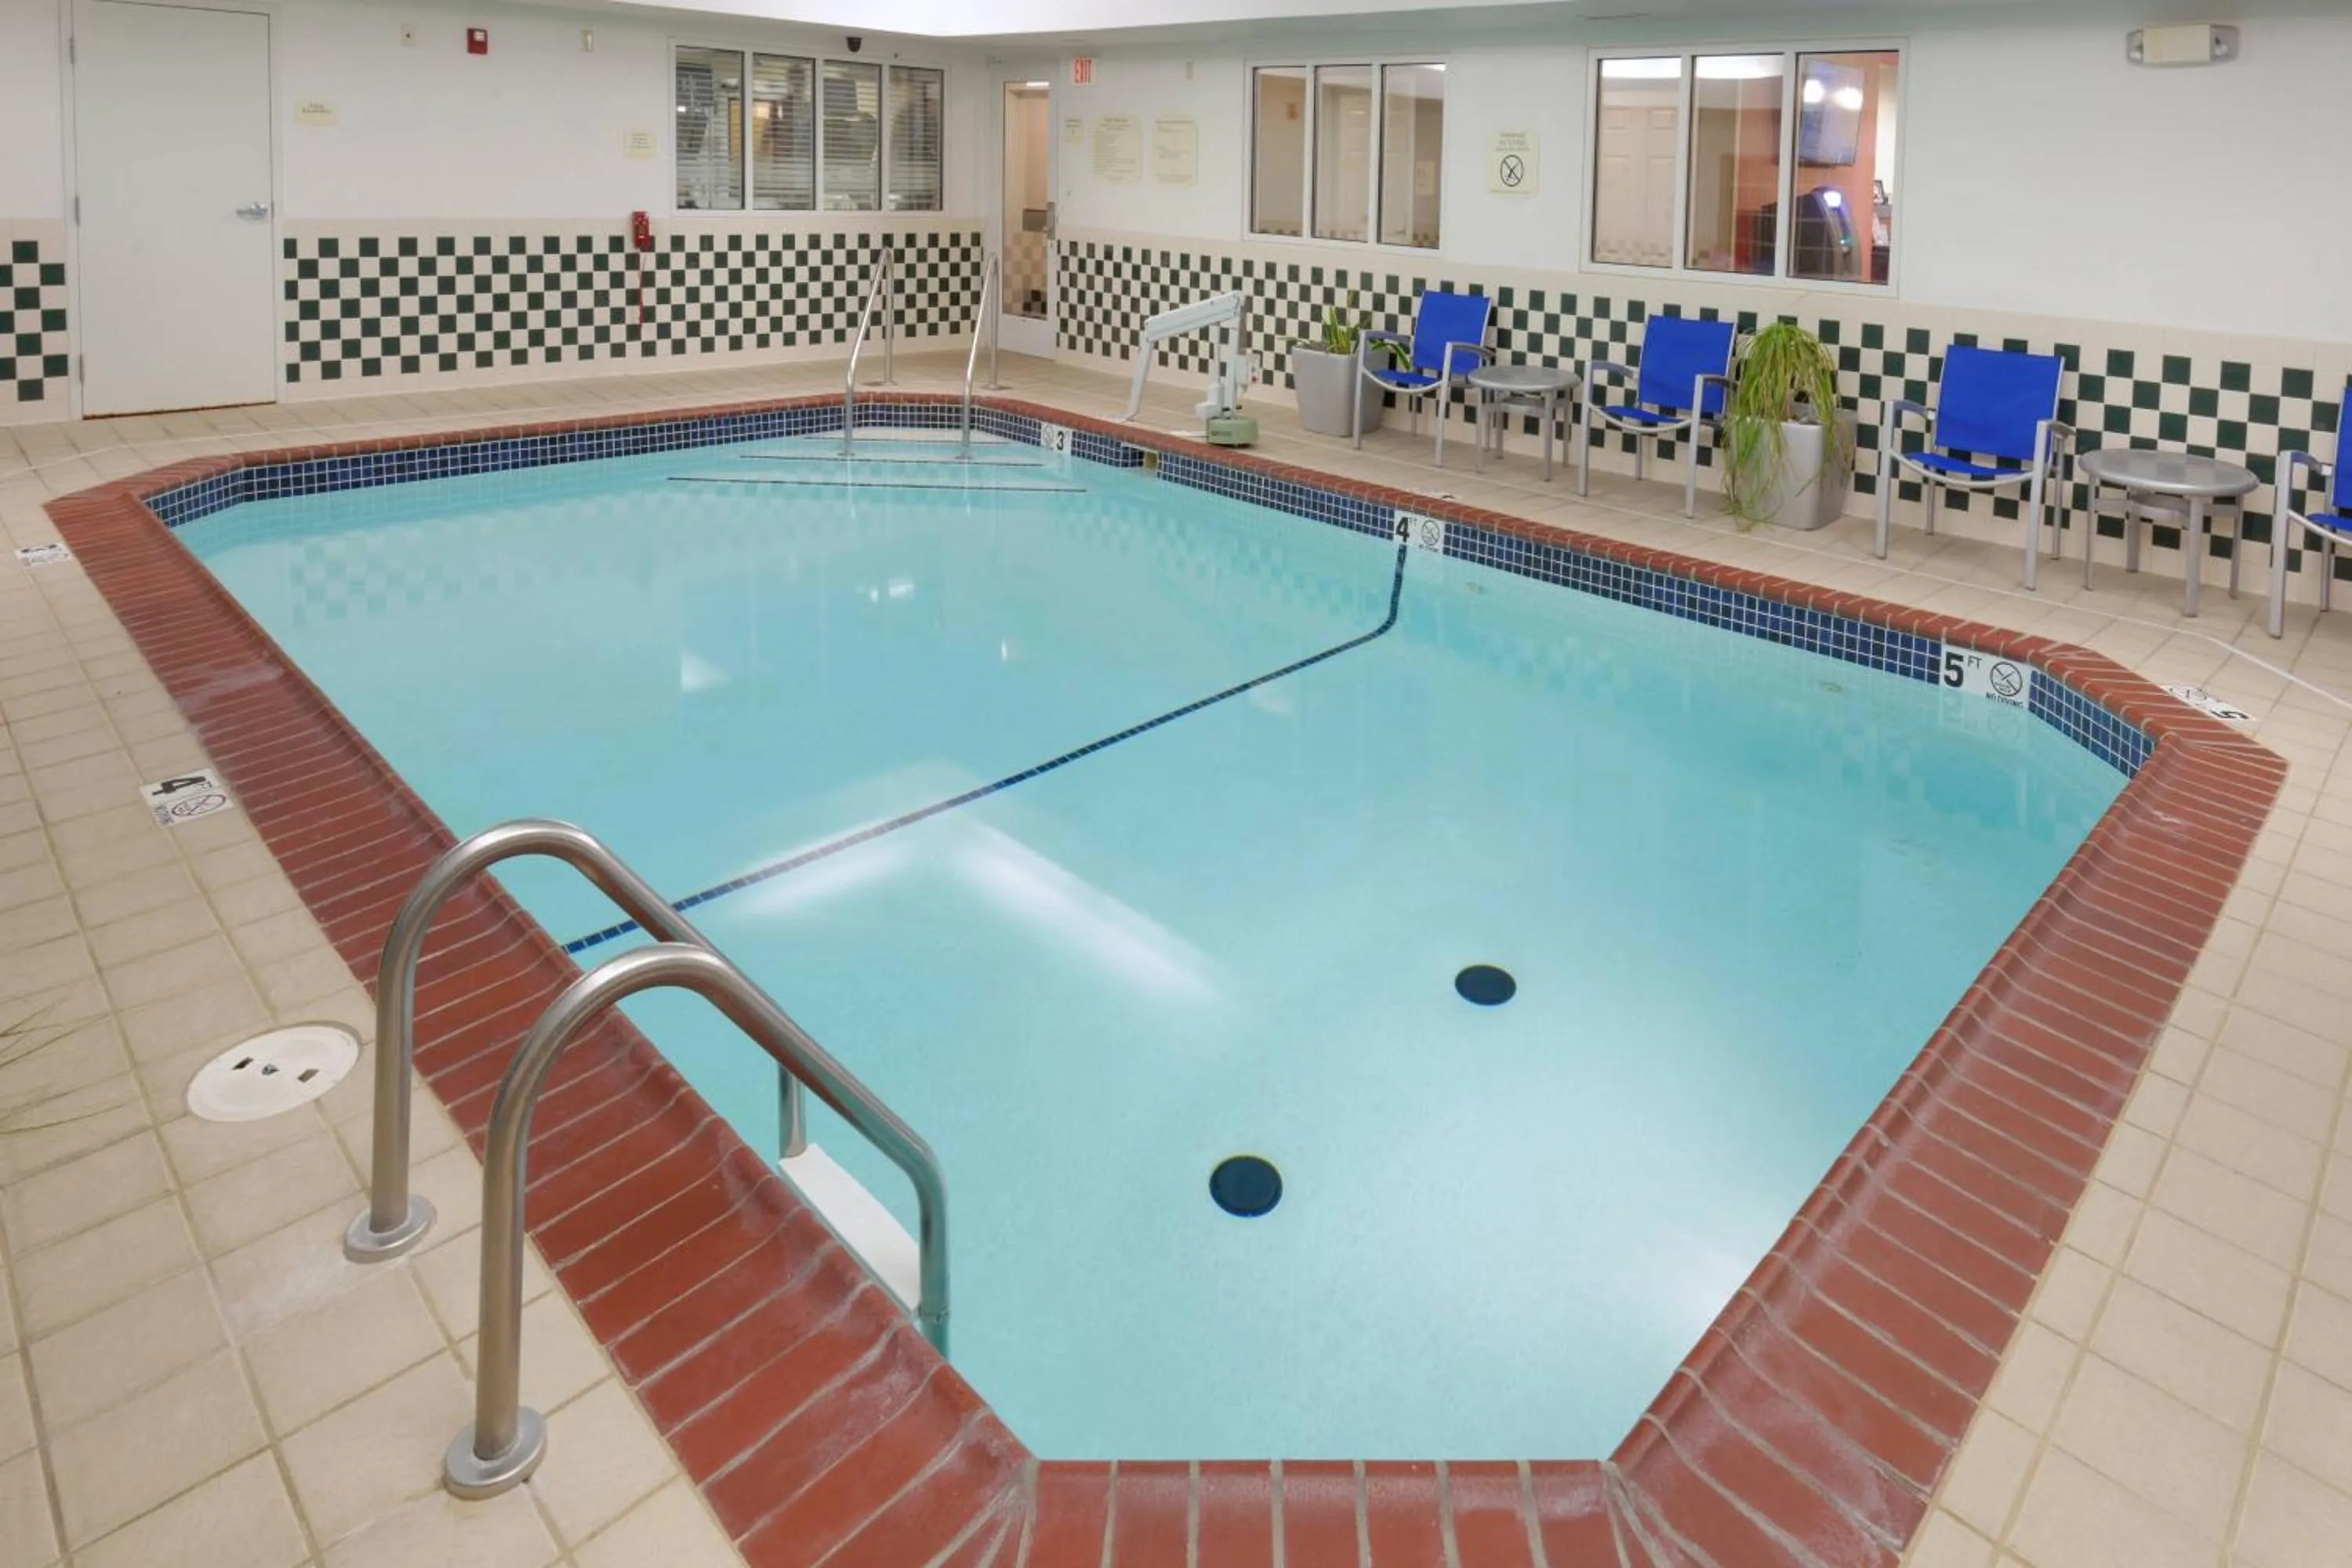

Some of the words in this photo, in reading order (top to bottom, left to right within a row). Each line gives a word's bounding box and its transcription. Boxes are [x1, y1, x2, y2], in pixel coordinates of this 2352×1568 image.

[1074, 59, 1092, 83] EXIT
[1056, 430, 1064, 451] 3
[1396, 517, 1410, 543] 4
[1944, 652, 1965, 688] 5
[1967, 655, 1983, 669] FT
[152, 776, 206, 796] 4
